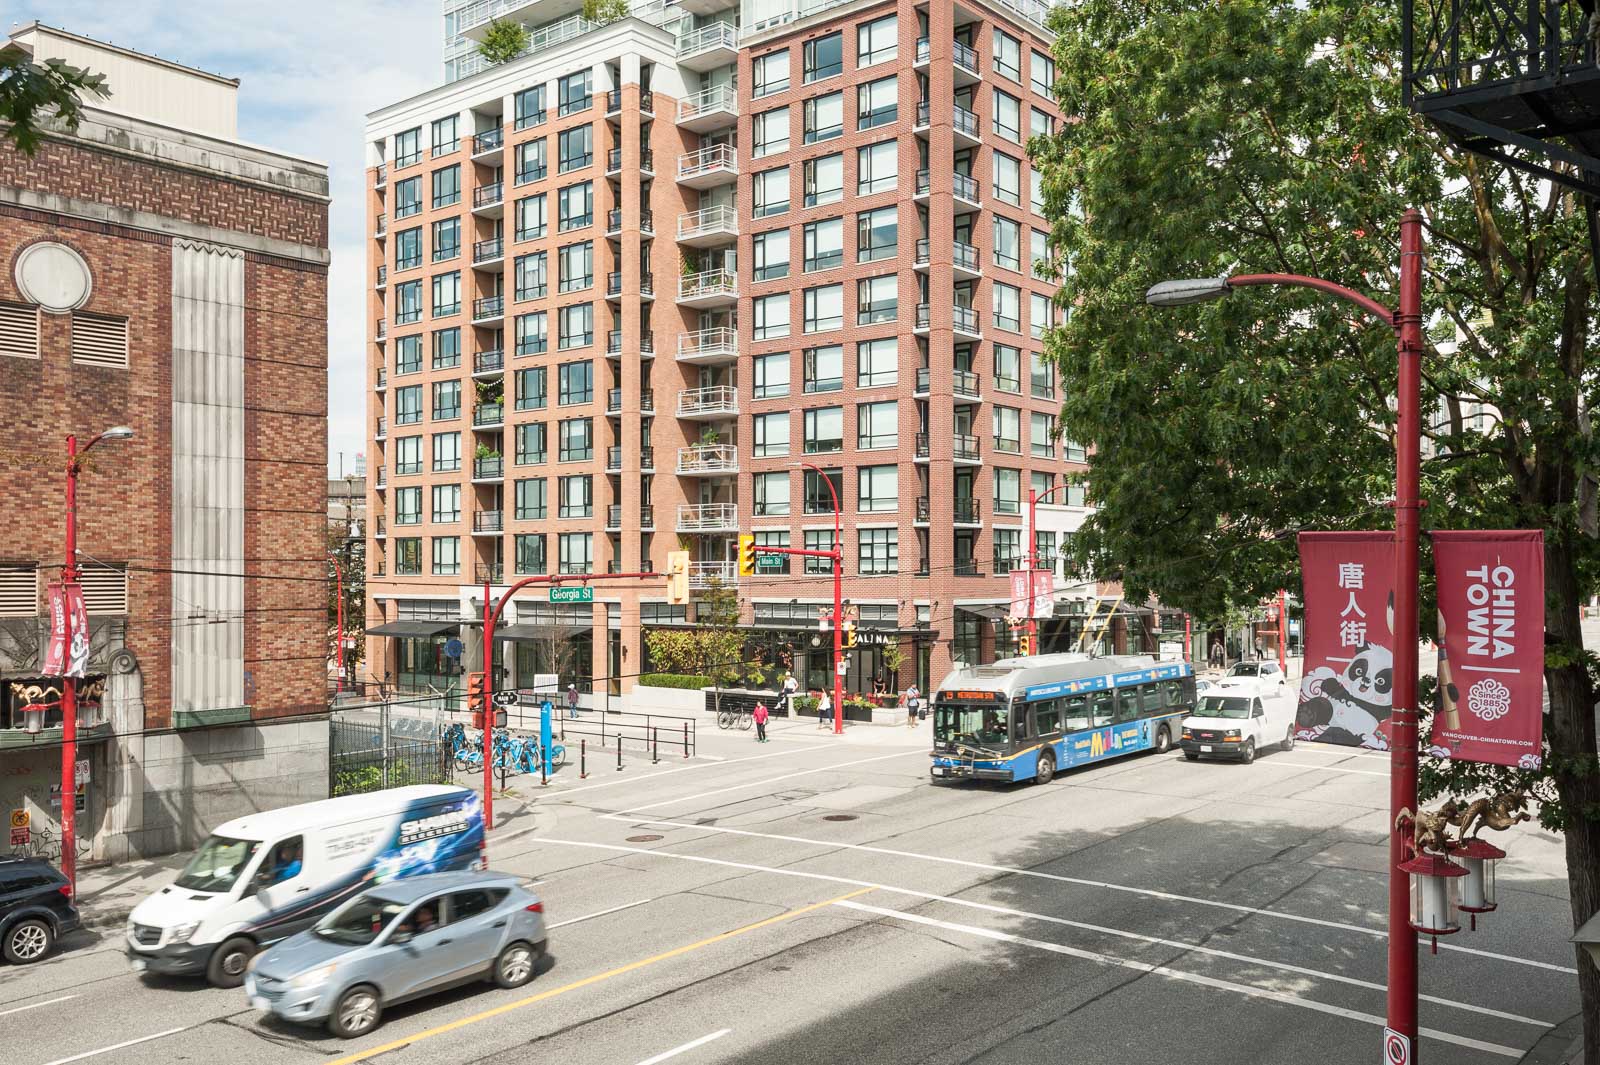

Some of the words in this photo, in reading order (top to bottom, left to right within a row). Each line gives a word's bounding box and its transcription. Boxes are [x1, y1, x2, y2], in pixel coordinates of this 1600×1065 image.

[552, 589, 580, 600] Georgia
[582, 588, 591, 598] St
[1338, 562, 1367, 648] 唐人街
[1466, 565, 1489, 656] TOWN
[1491, 565, 1515, 660] CHINA
[1478, 691, 1502, 700] Since
[1479, 699, 1501, 708] 1885
[1441, 731, 1534, 747] VANCOUVER-CHINATOWN.COM
